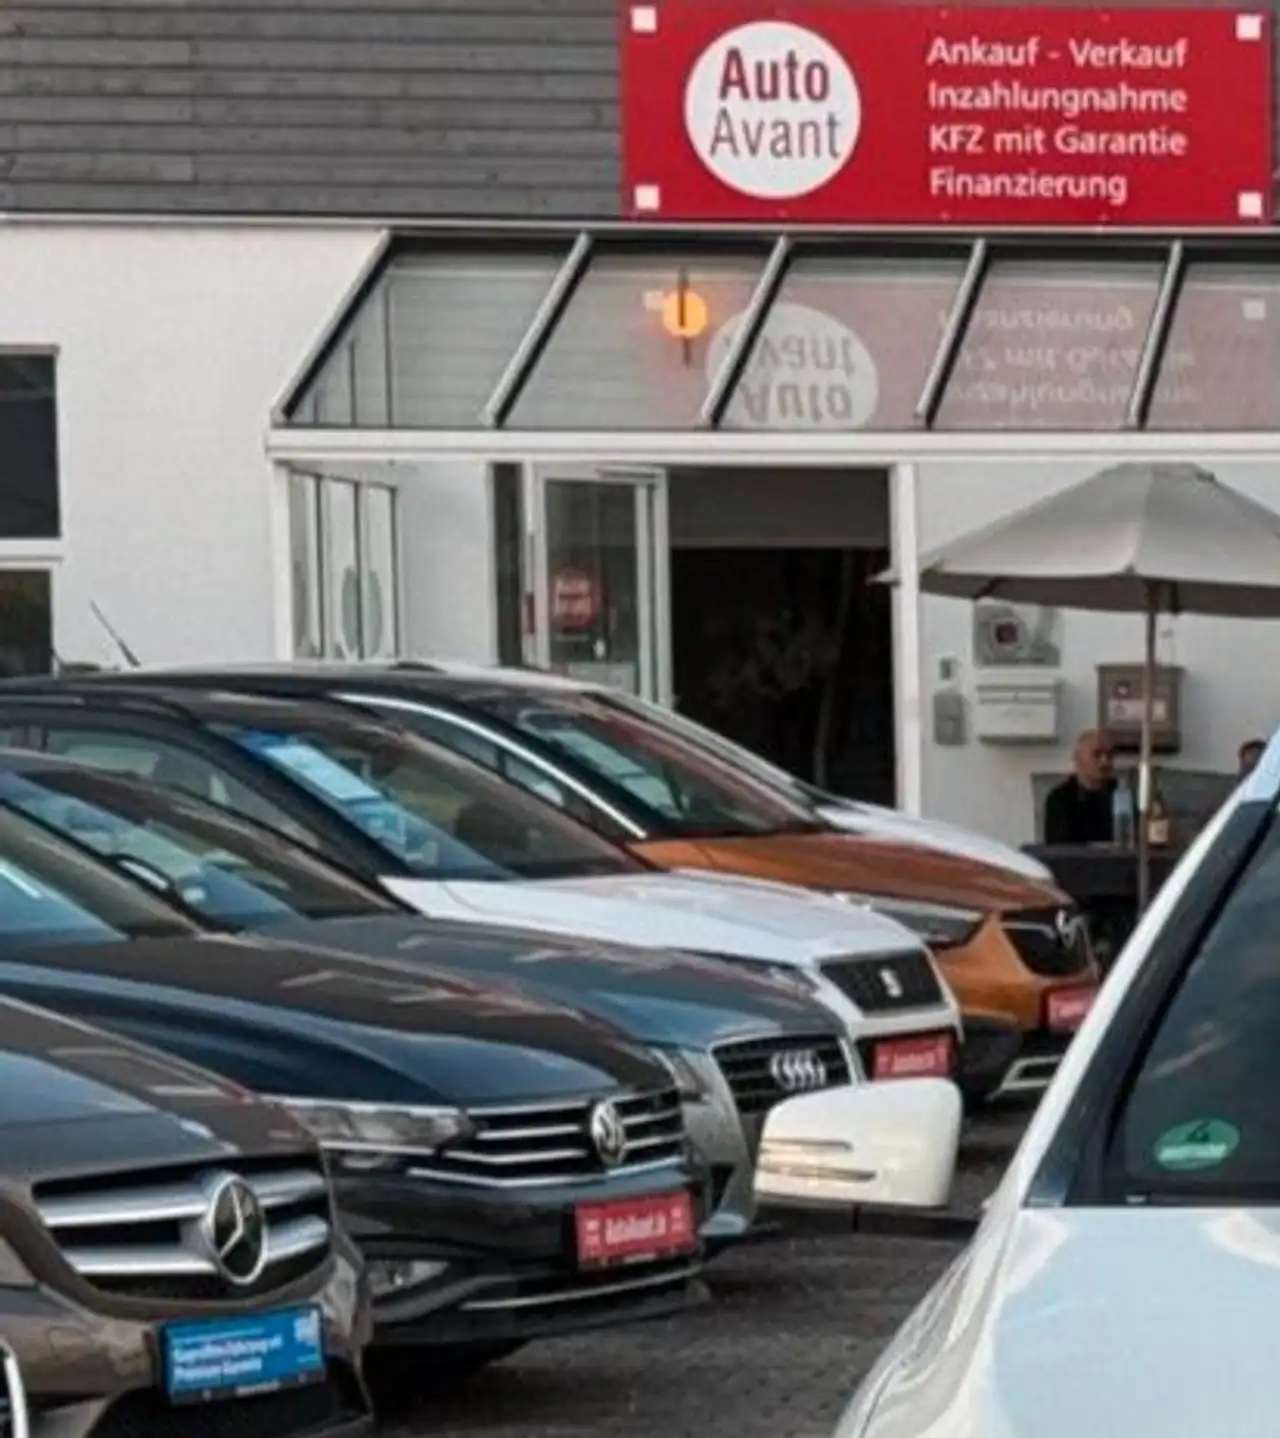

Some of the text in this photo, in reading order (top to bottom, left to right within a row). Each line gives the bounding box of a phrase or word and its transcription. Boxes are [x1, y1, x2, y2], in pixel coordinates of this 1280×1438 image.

[926, 35, 1040, 67] Ankauf
[1068, 37, 1189, 69] Verkauf
[718, 46, 830, 103] Auto
[928, 80, 1188, 118] Inzahlungnahme
[709, 106, 842, 159] Avant
[929, 124, 1188, 157] KFZ mit Garantie
[929, 165, 1129, 206] Finanzierung
